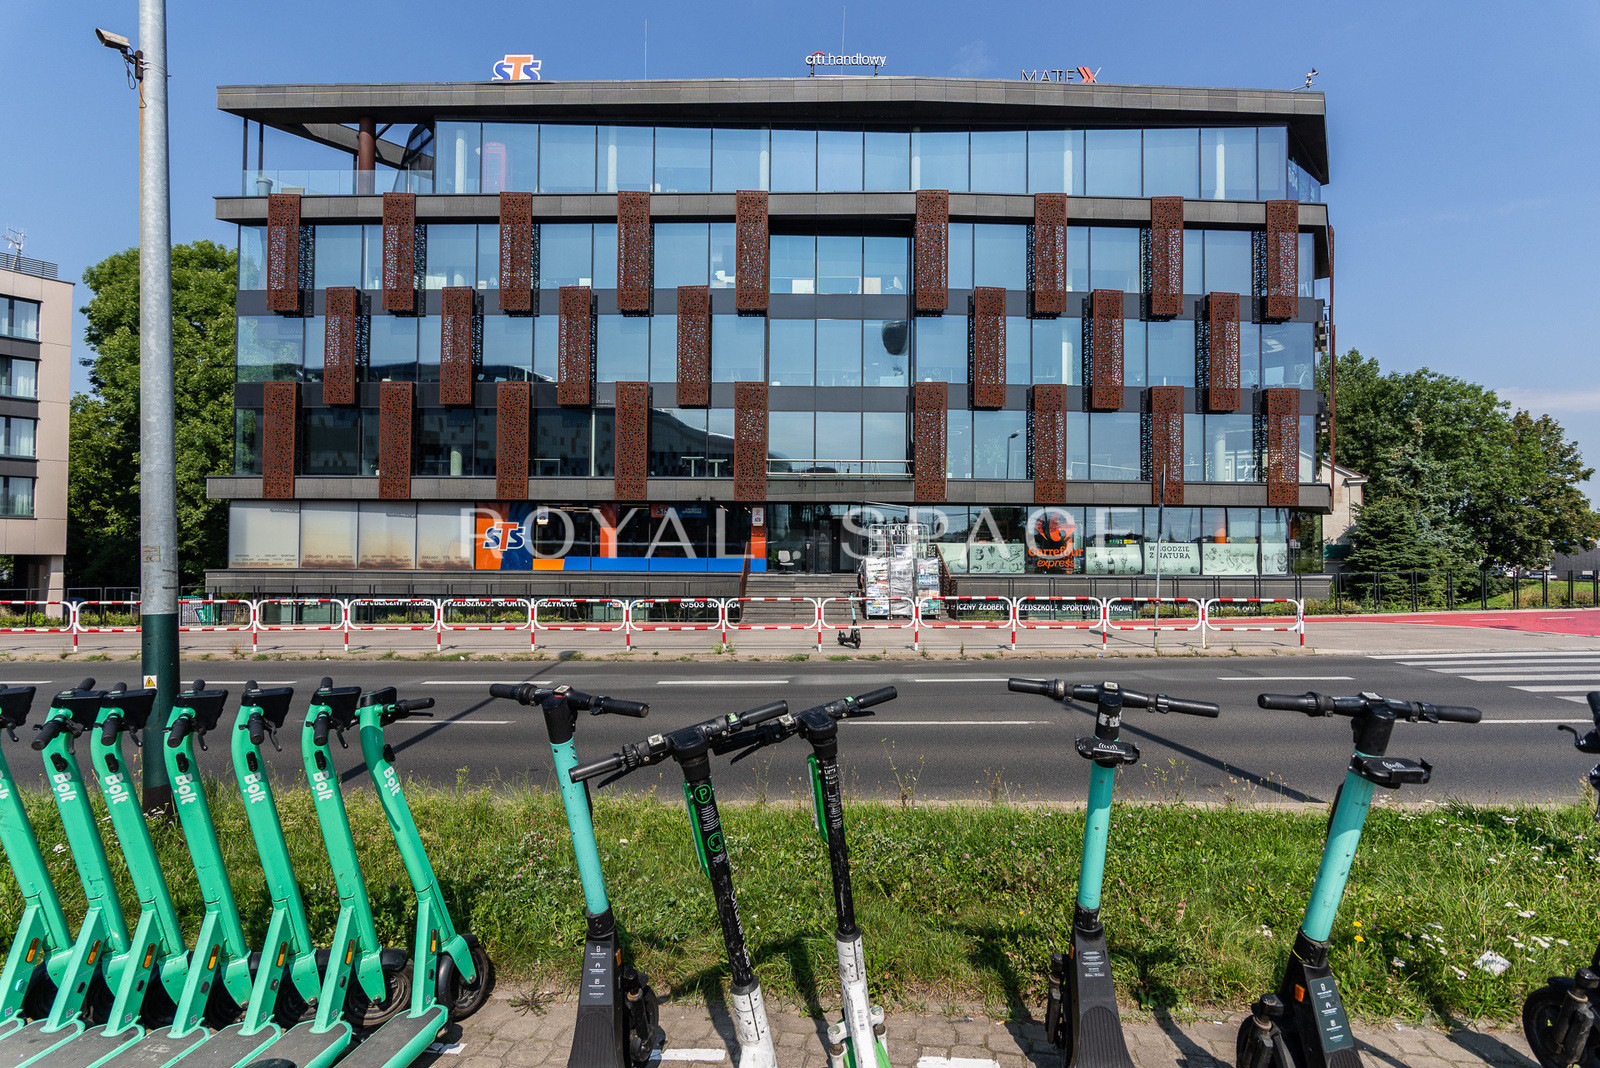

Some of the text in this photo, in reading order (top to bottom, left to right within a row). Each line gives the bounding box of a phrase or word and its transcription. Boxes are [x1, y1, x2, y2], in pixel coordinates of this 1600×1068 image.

[491, 54, 542, 81] STS
[805, 51, 887, 68] citi handlowy
[482, 521, 527, 551] STS
[1028, 546, 1084, 557] Carrefour
[1036, 559, 1076, 570] express
[53, 771, 78, 803] Bolt
[104, 772, 130, 805] Bolt
[174, 773, 198, 805] Bolt
[242, 772, 267, 804] Bolt
[311, 770, 334, 802] Bolt
[383, 766, 401, 797] Bolt
